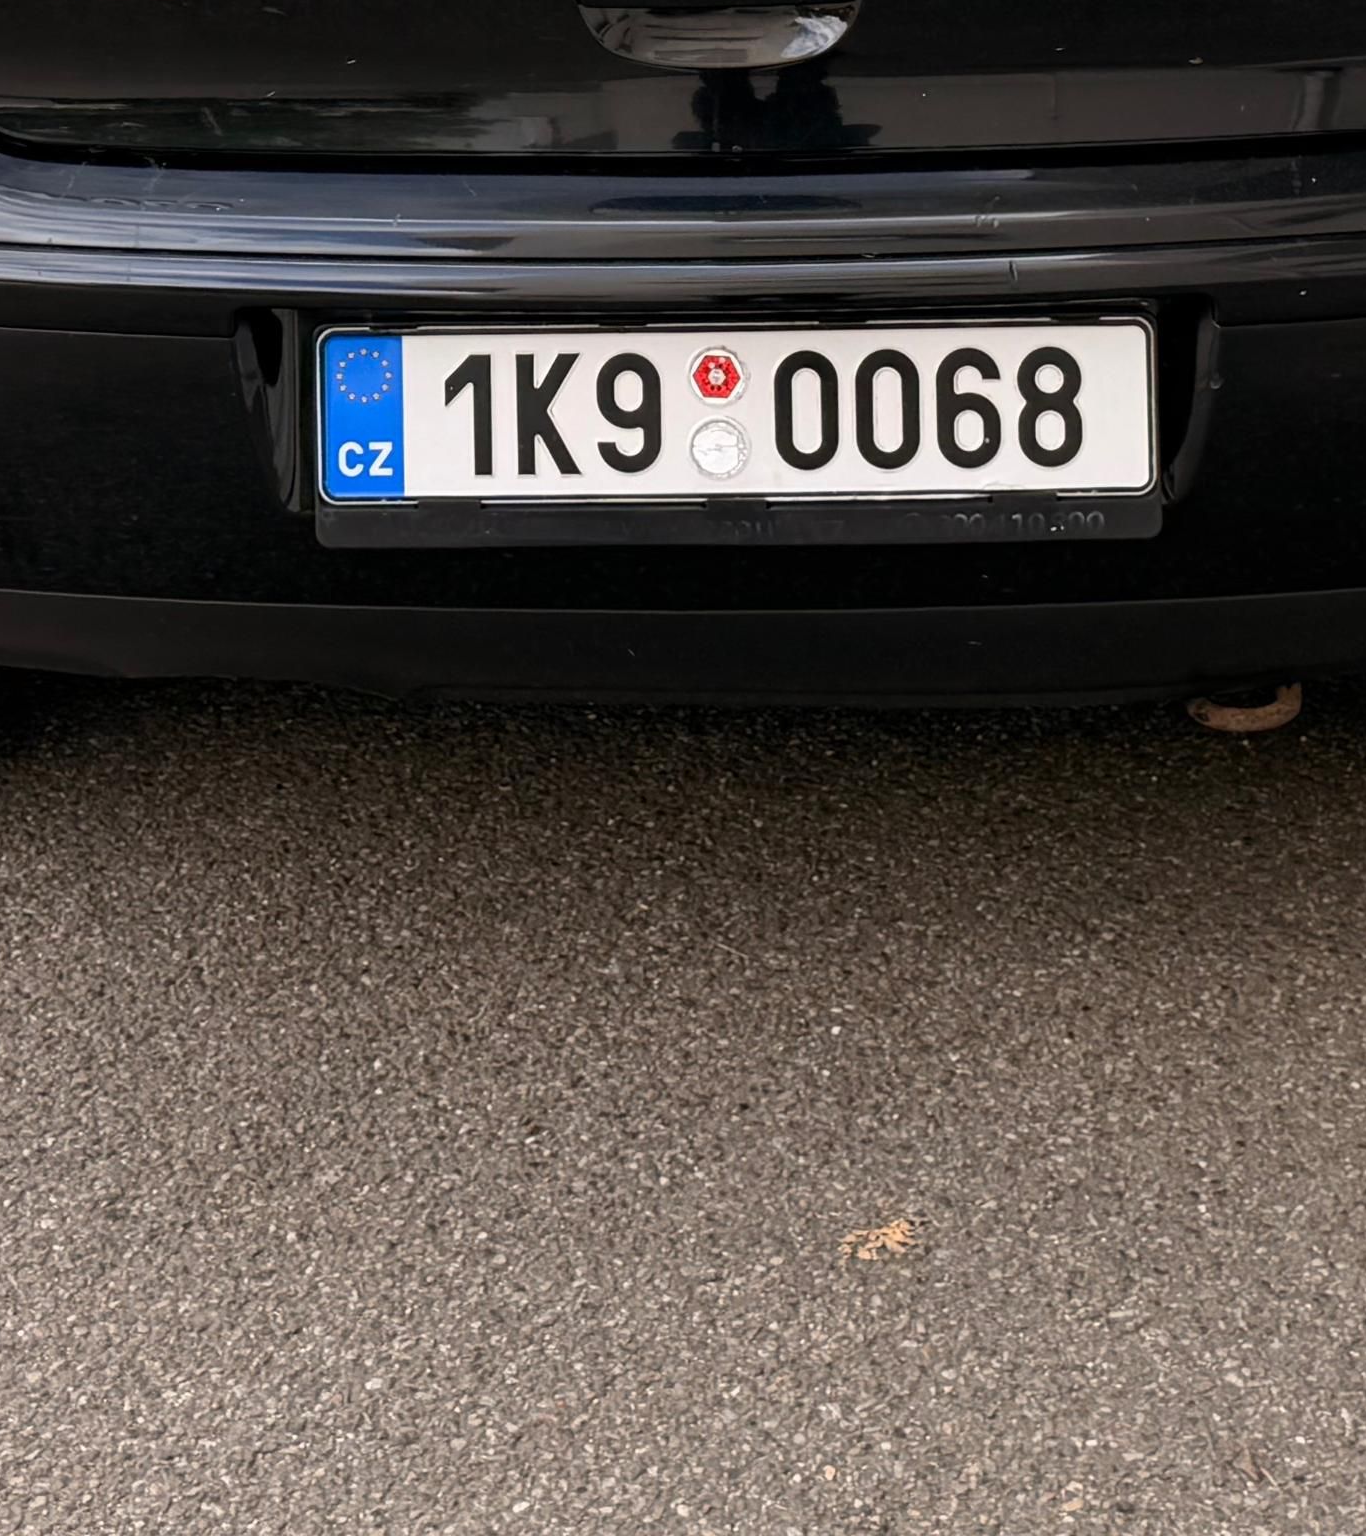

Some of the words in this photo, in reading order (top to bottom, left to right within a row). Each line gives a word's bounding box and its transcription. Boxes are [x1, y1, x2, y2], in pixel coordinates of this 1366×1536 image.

[443, 351, 664, 478] 1K9
[773, 345, 1085, 473] 0068
[337, 440, 395, 478] CZ
